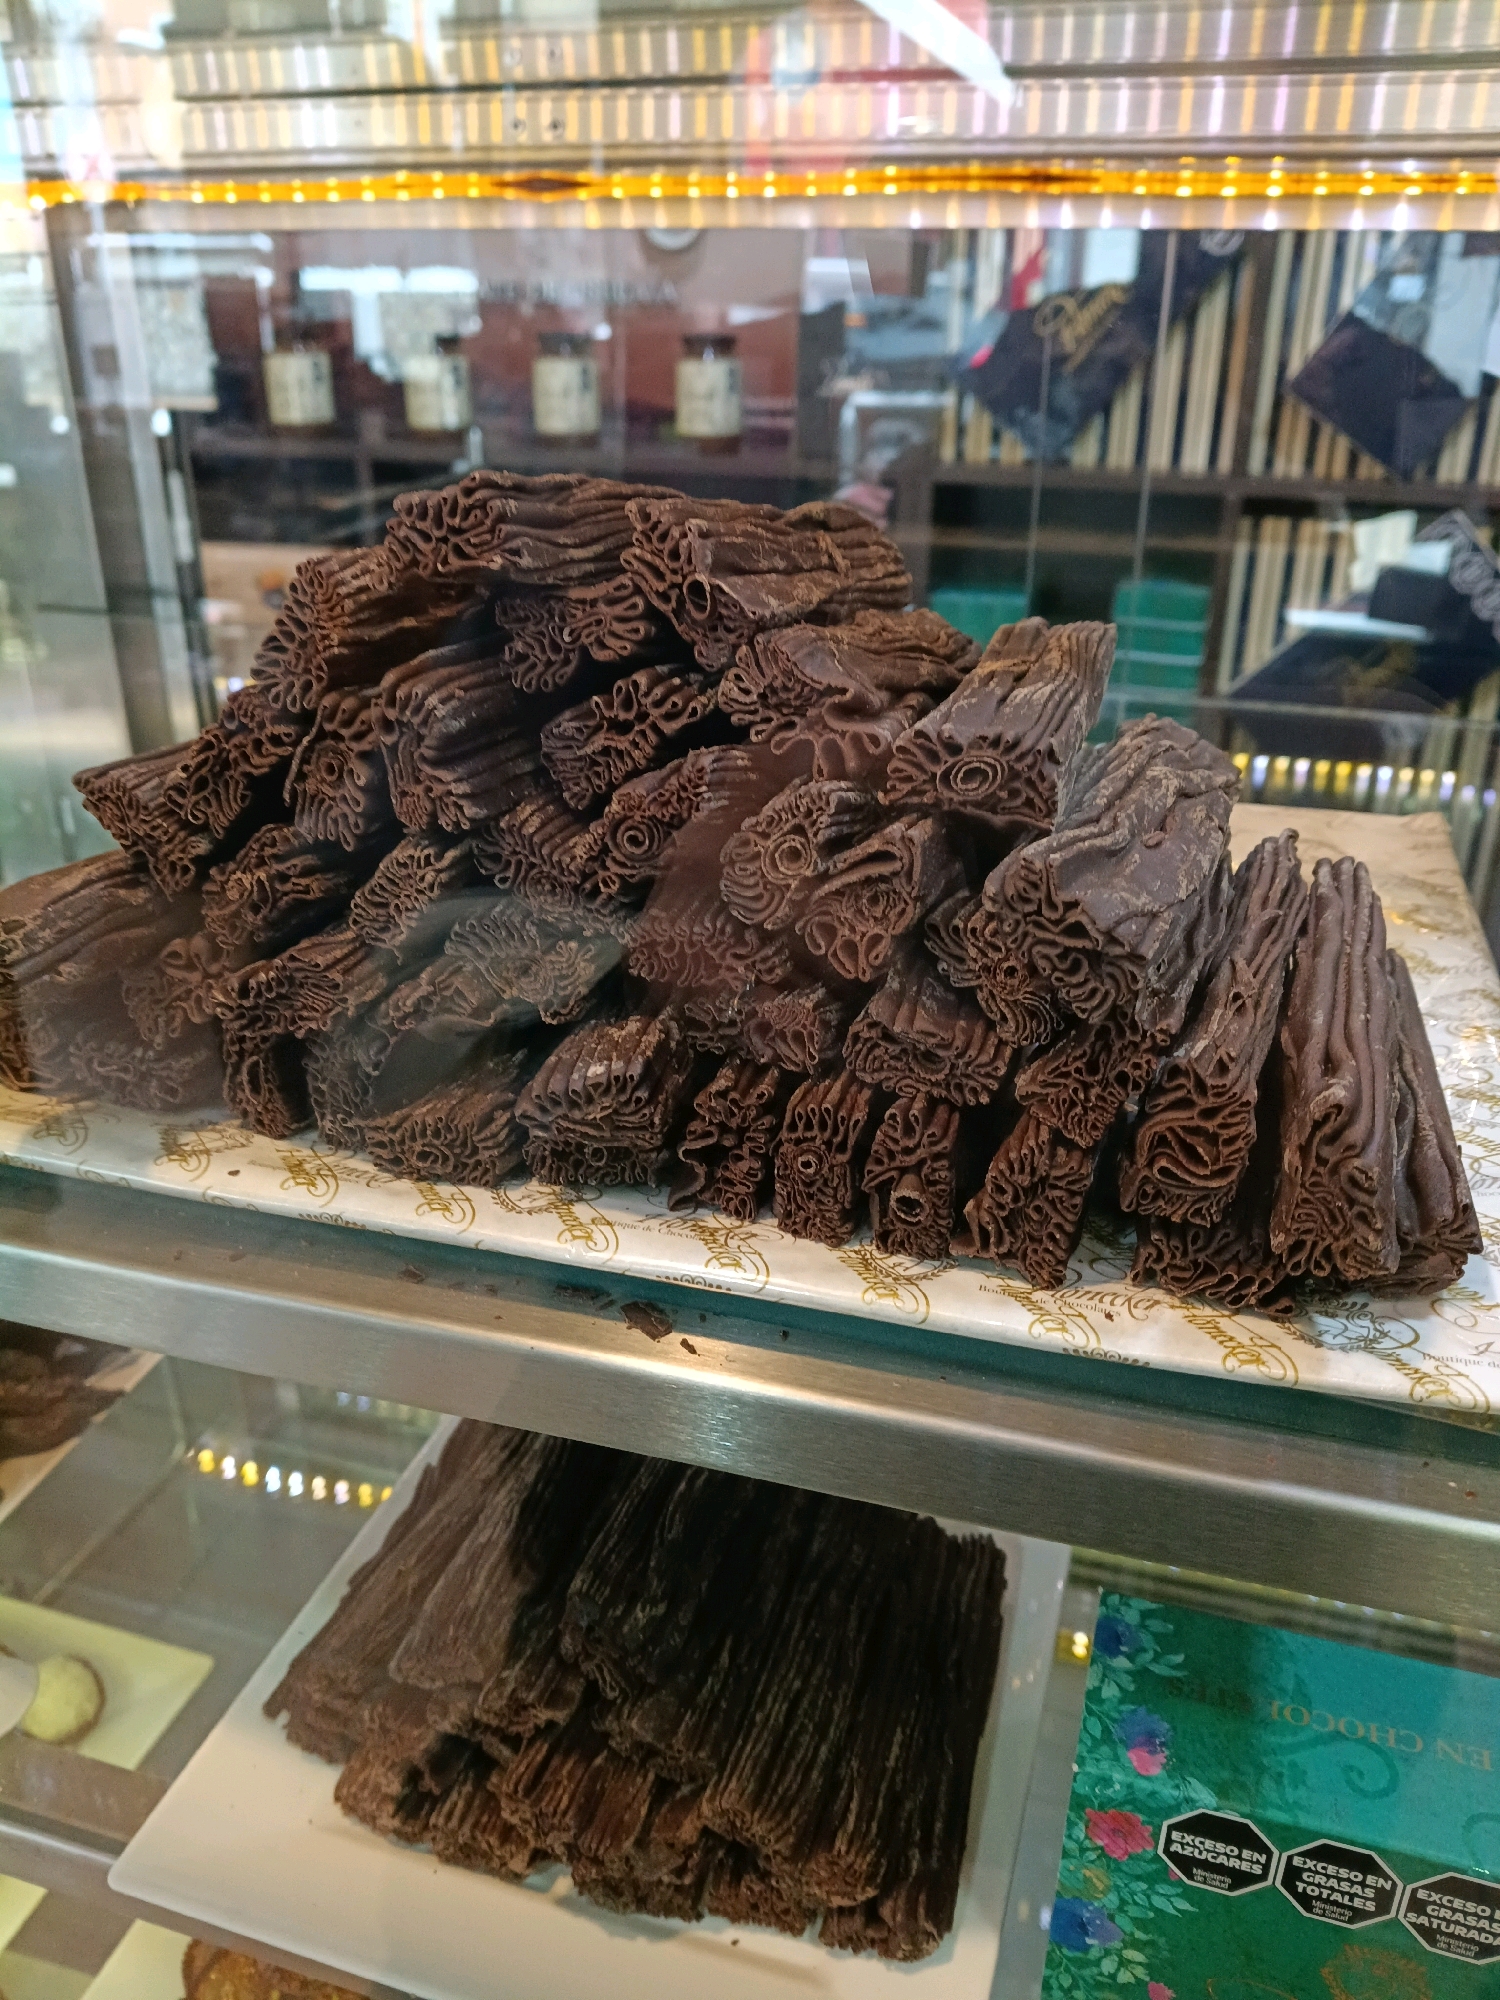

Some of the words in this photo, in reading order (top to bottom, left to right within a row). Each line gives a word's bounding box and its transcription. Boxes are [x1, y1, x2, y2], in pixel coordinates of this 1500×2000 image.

[1436, 1738, 1494, 1771] EN
[1171, 1830, 1239, 1857] EXCESO
[1241, 1849, 1267, 1864] EN
[1192, 1867, 1232, 1884] Ministerio
[1194, 1875, 1205, 1883] de
[1206, 1877, 1229, 1889] Salud
[1292, 1855, 1364, 1882] EXCESO
[1365, 1874, 1393, 1891] EN
[1302, 1871, 1376, 1898] GRASAS
[1295, 1881, 1376, 1912] TOTALES
[1311, 1900, 1353, 1917] Ministerio
[1416, 1888, 1492, 1917] EXCESO
[1312, 1907, 1324, 1915] de
[1325, 1910, 1349, 1922] Salud
[1405, 1912, 1500, 1946] SATURADA
[1436, 1934, 1479, 1952] Ministerio
[1437, 1941, 1449, 1950] de
[1449, 1945, 1475, 1958] Salud
